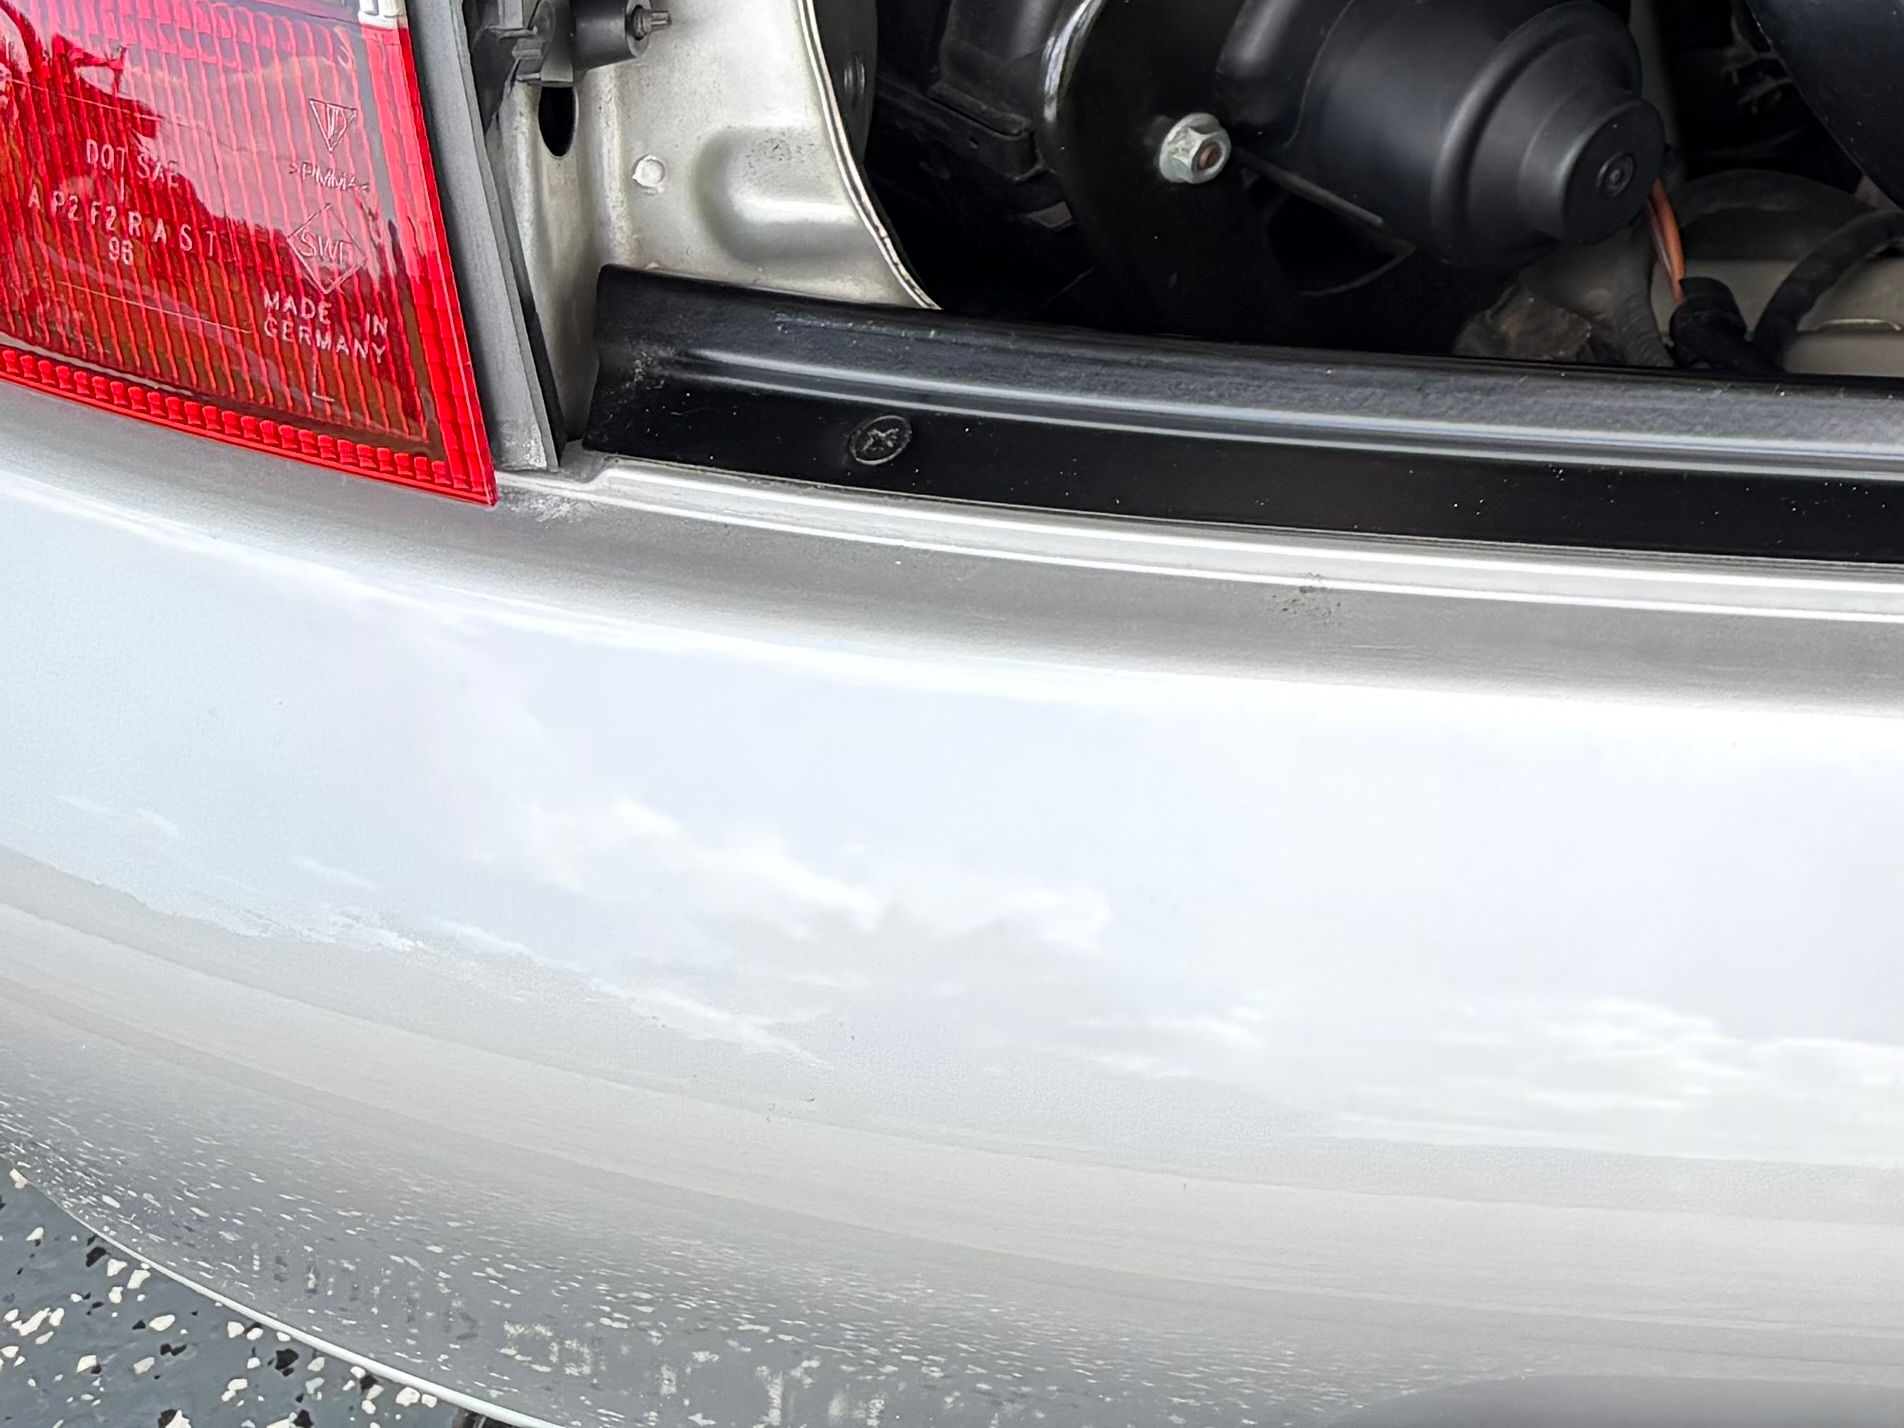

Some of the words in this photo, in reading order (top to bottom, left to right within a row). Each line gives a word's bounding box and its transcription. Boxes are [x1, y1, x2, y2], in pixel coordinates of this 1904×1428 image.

[86, 139, 128, 171] DOT
[263, 291, 332, 325] MADE
[365, 313, 390, 338] IN
[264, 318, 389, 365] GERMANY
